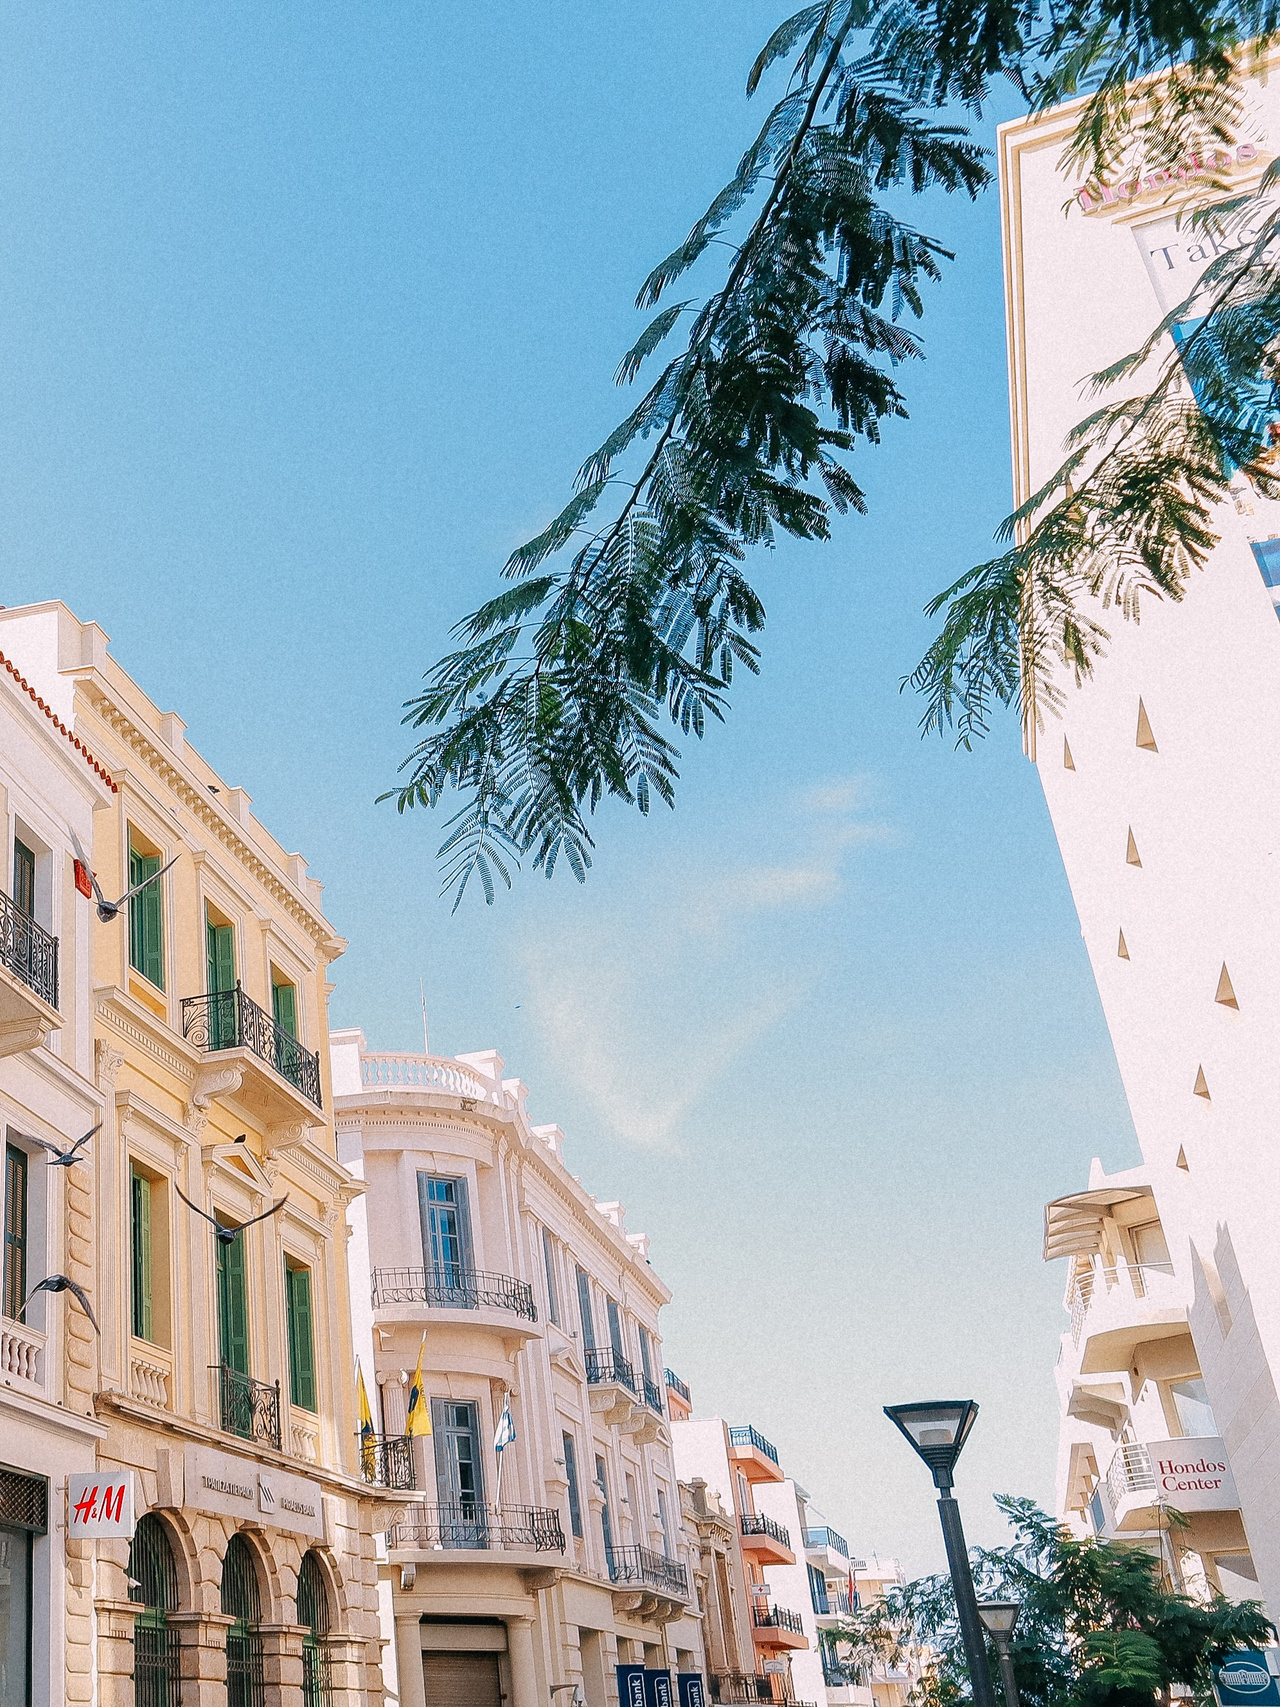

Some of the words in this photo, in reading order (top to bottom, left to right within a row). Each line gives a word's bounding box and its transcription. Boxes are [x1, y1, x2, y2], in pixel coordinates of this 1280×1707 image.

[1157, 1459, 1226, 1475] Hondos
[1162, 1476, 1222, 1491] Center
[73, 1485, 125, 1524] H&M
[632, 1679, 644, 1707] bank
